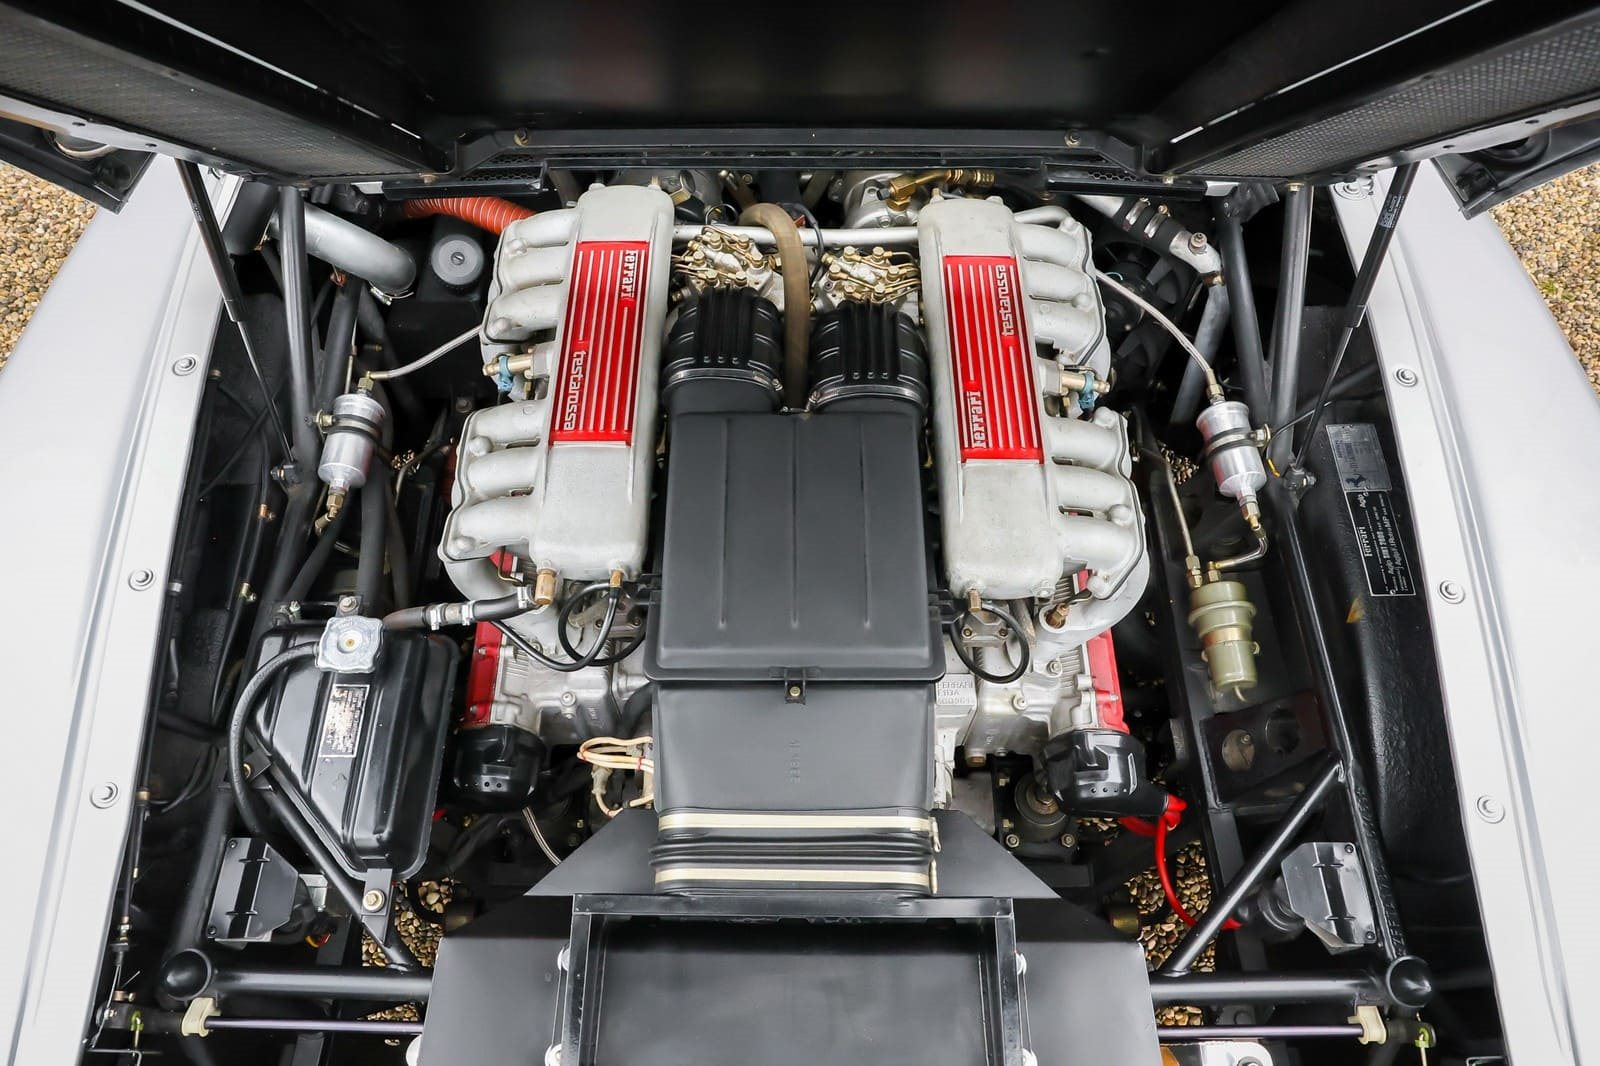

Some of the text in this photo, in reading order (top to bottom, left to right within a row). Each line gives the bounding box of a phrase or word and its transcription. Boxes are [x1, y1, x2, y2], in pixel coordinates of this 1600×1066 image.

[621, 249, 639, 299] Ferrari
[995, 264, 1015, 337] testarossa
[563, 350, 587, 431] testarossa
[966, 390, 987, 449] Ferrari
